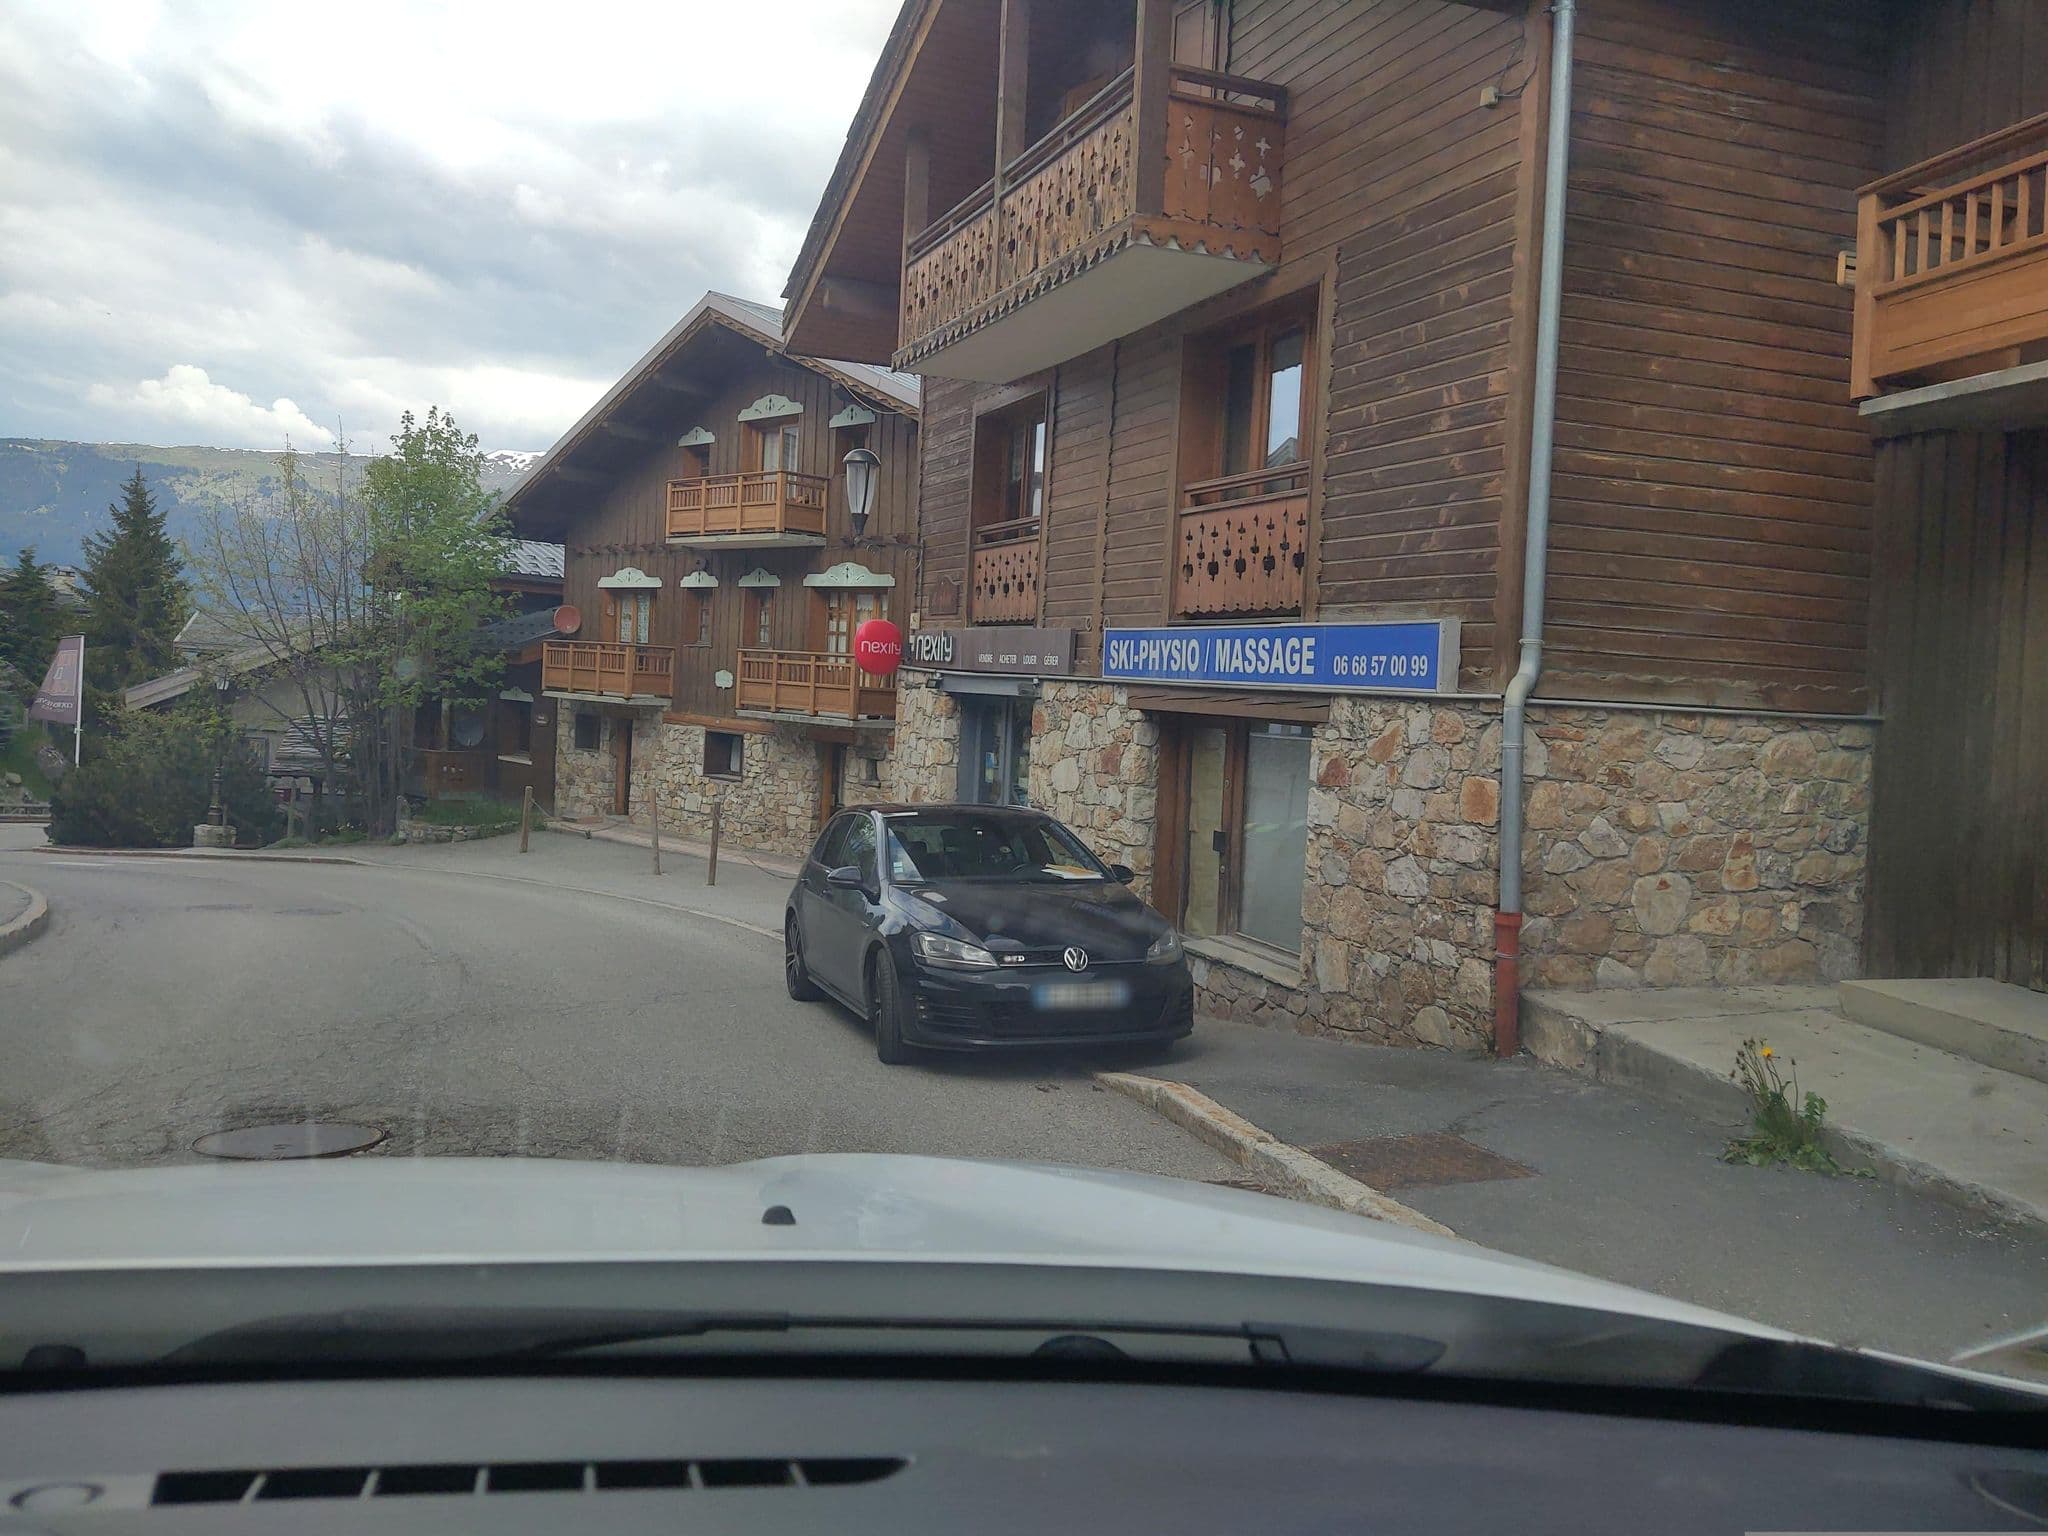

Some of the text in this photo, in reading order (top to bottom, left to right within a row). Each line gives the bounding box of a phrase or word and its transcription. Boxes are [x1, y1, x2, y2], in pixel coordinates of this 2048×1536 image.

[860, 639, 902, 655] nexity
[915, 630, 953, 663] nexity
[1109, 638, 1199, 672] SKI-PHYSIO
[1215, 637, 1315, 675] MASSAGE
[978, 652, 1059, 666] VENDRE ACHETER LOUER GÉRER
[1333, 655, 1428, 677] 06 68 57 00 99
